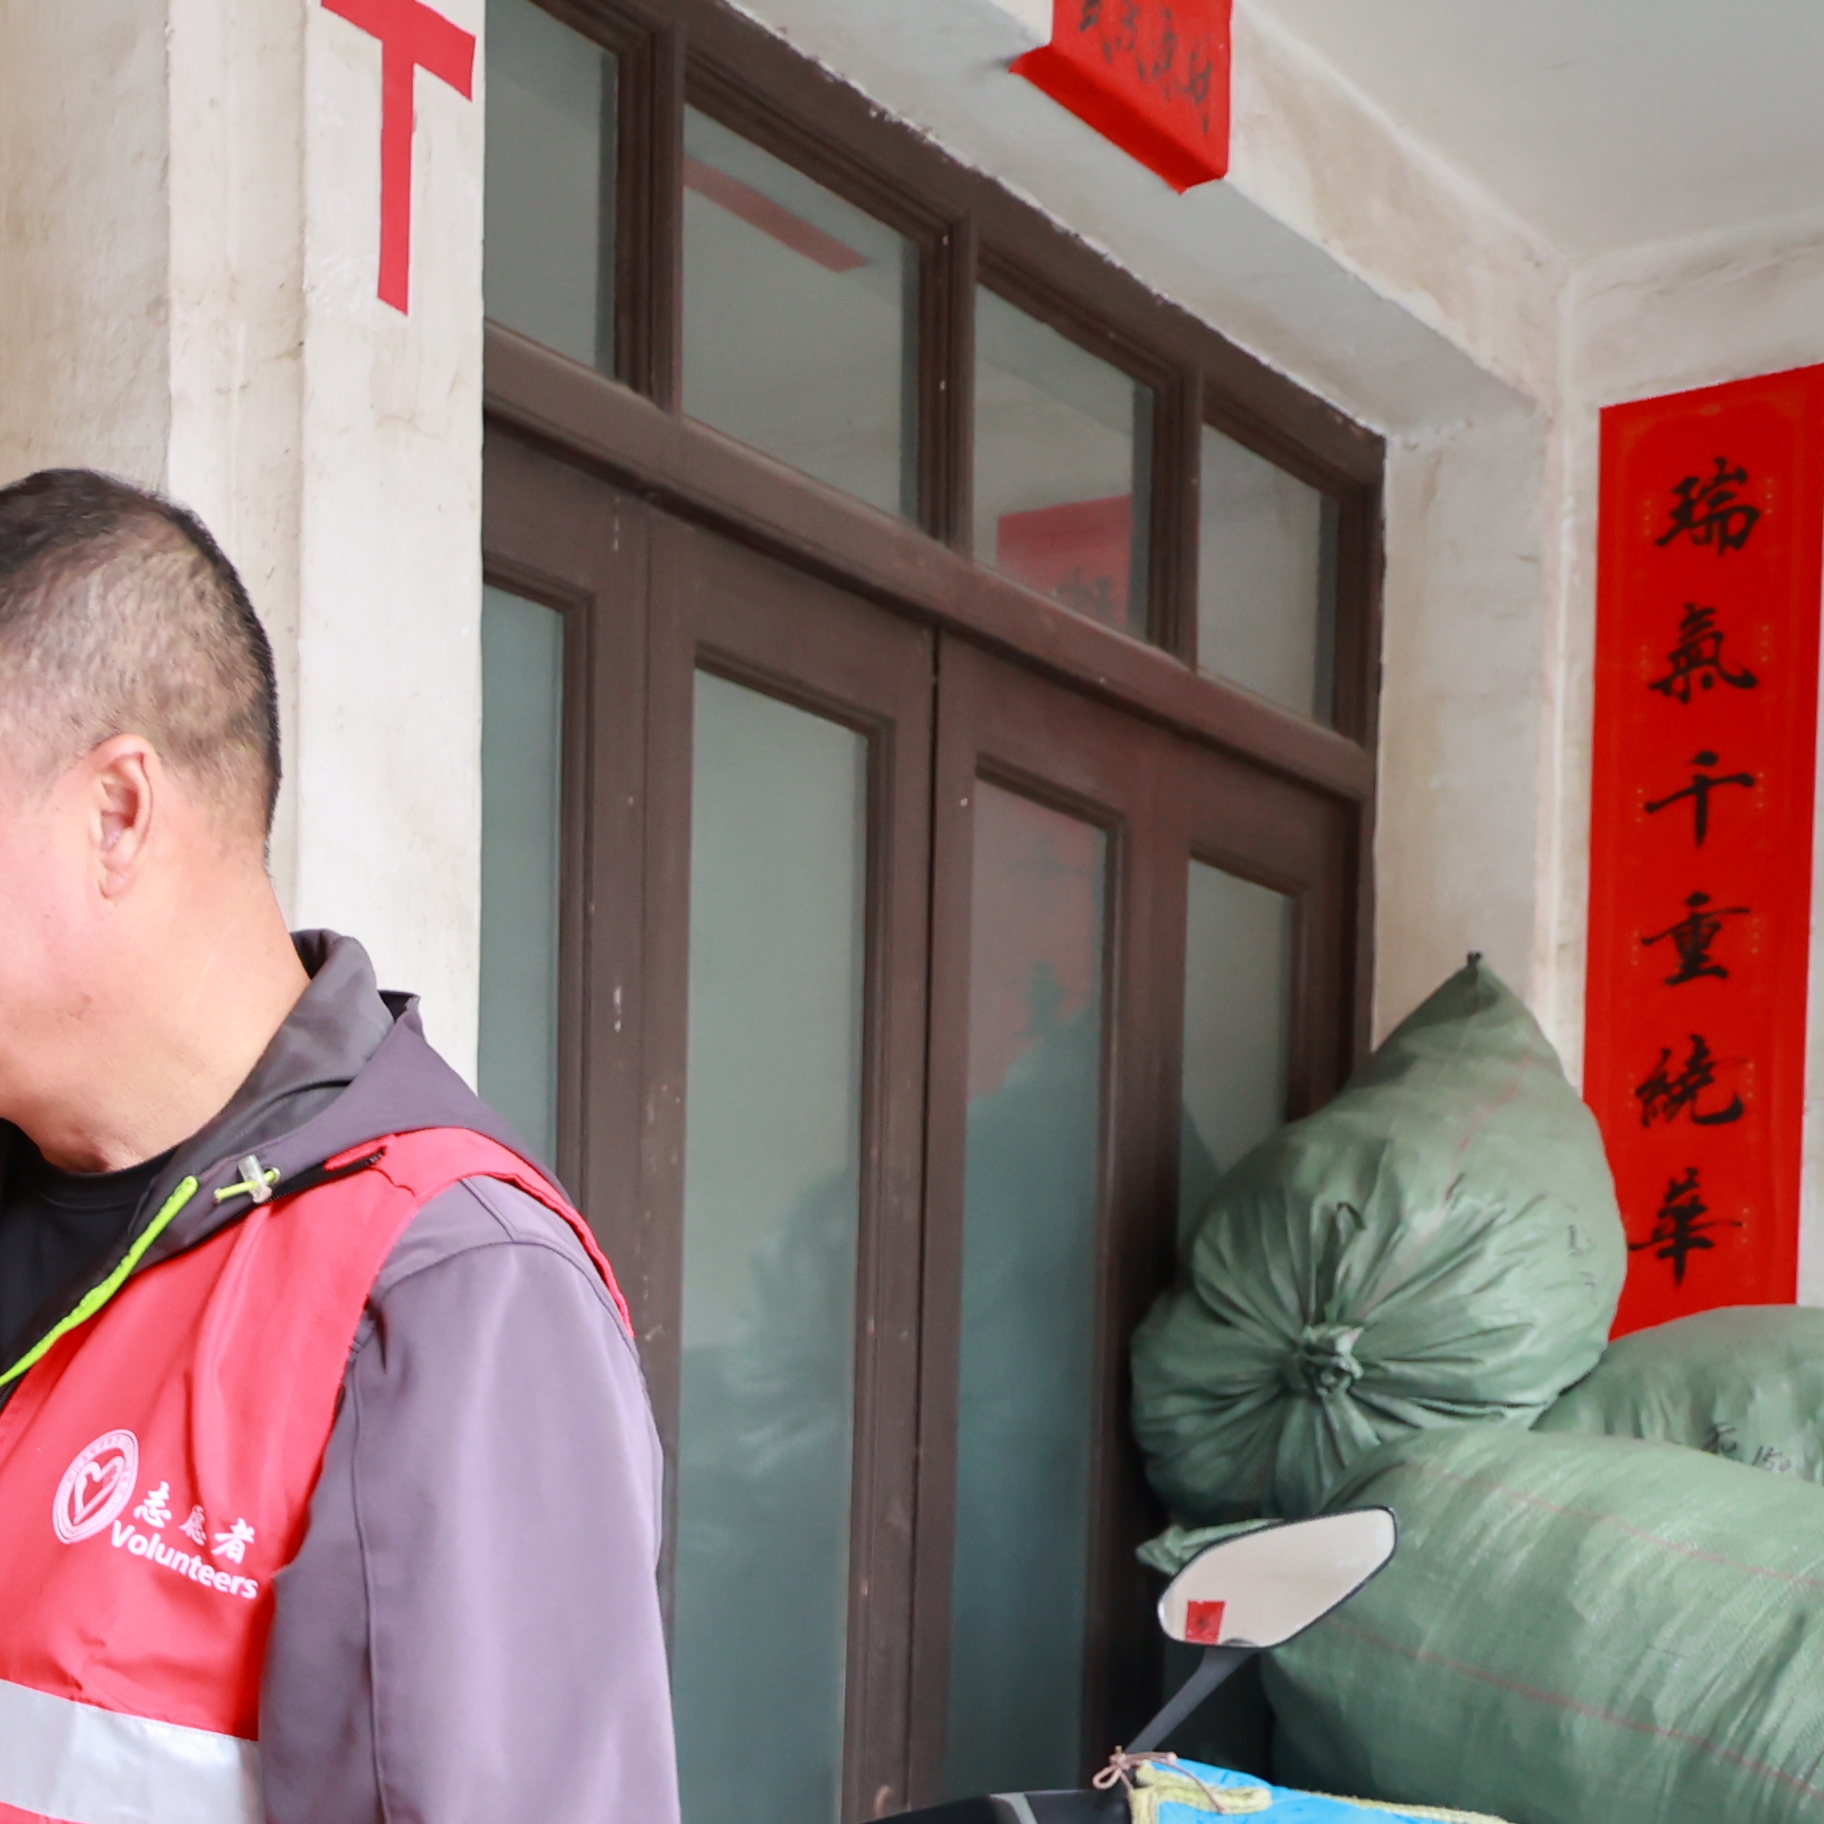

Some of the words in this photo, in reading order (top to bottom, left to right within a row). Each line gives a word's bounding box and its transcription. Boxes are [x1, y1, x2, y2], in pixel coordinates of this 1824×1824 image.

[110, 1519, 258, 1600] Volunteers
[133, 1480, 256, 1564] 志愿者
